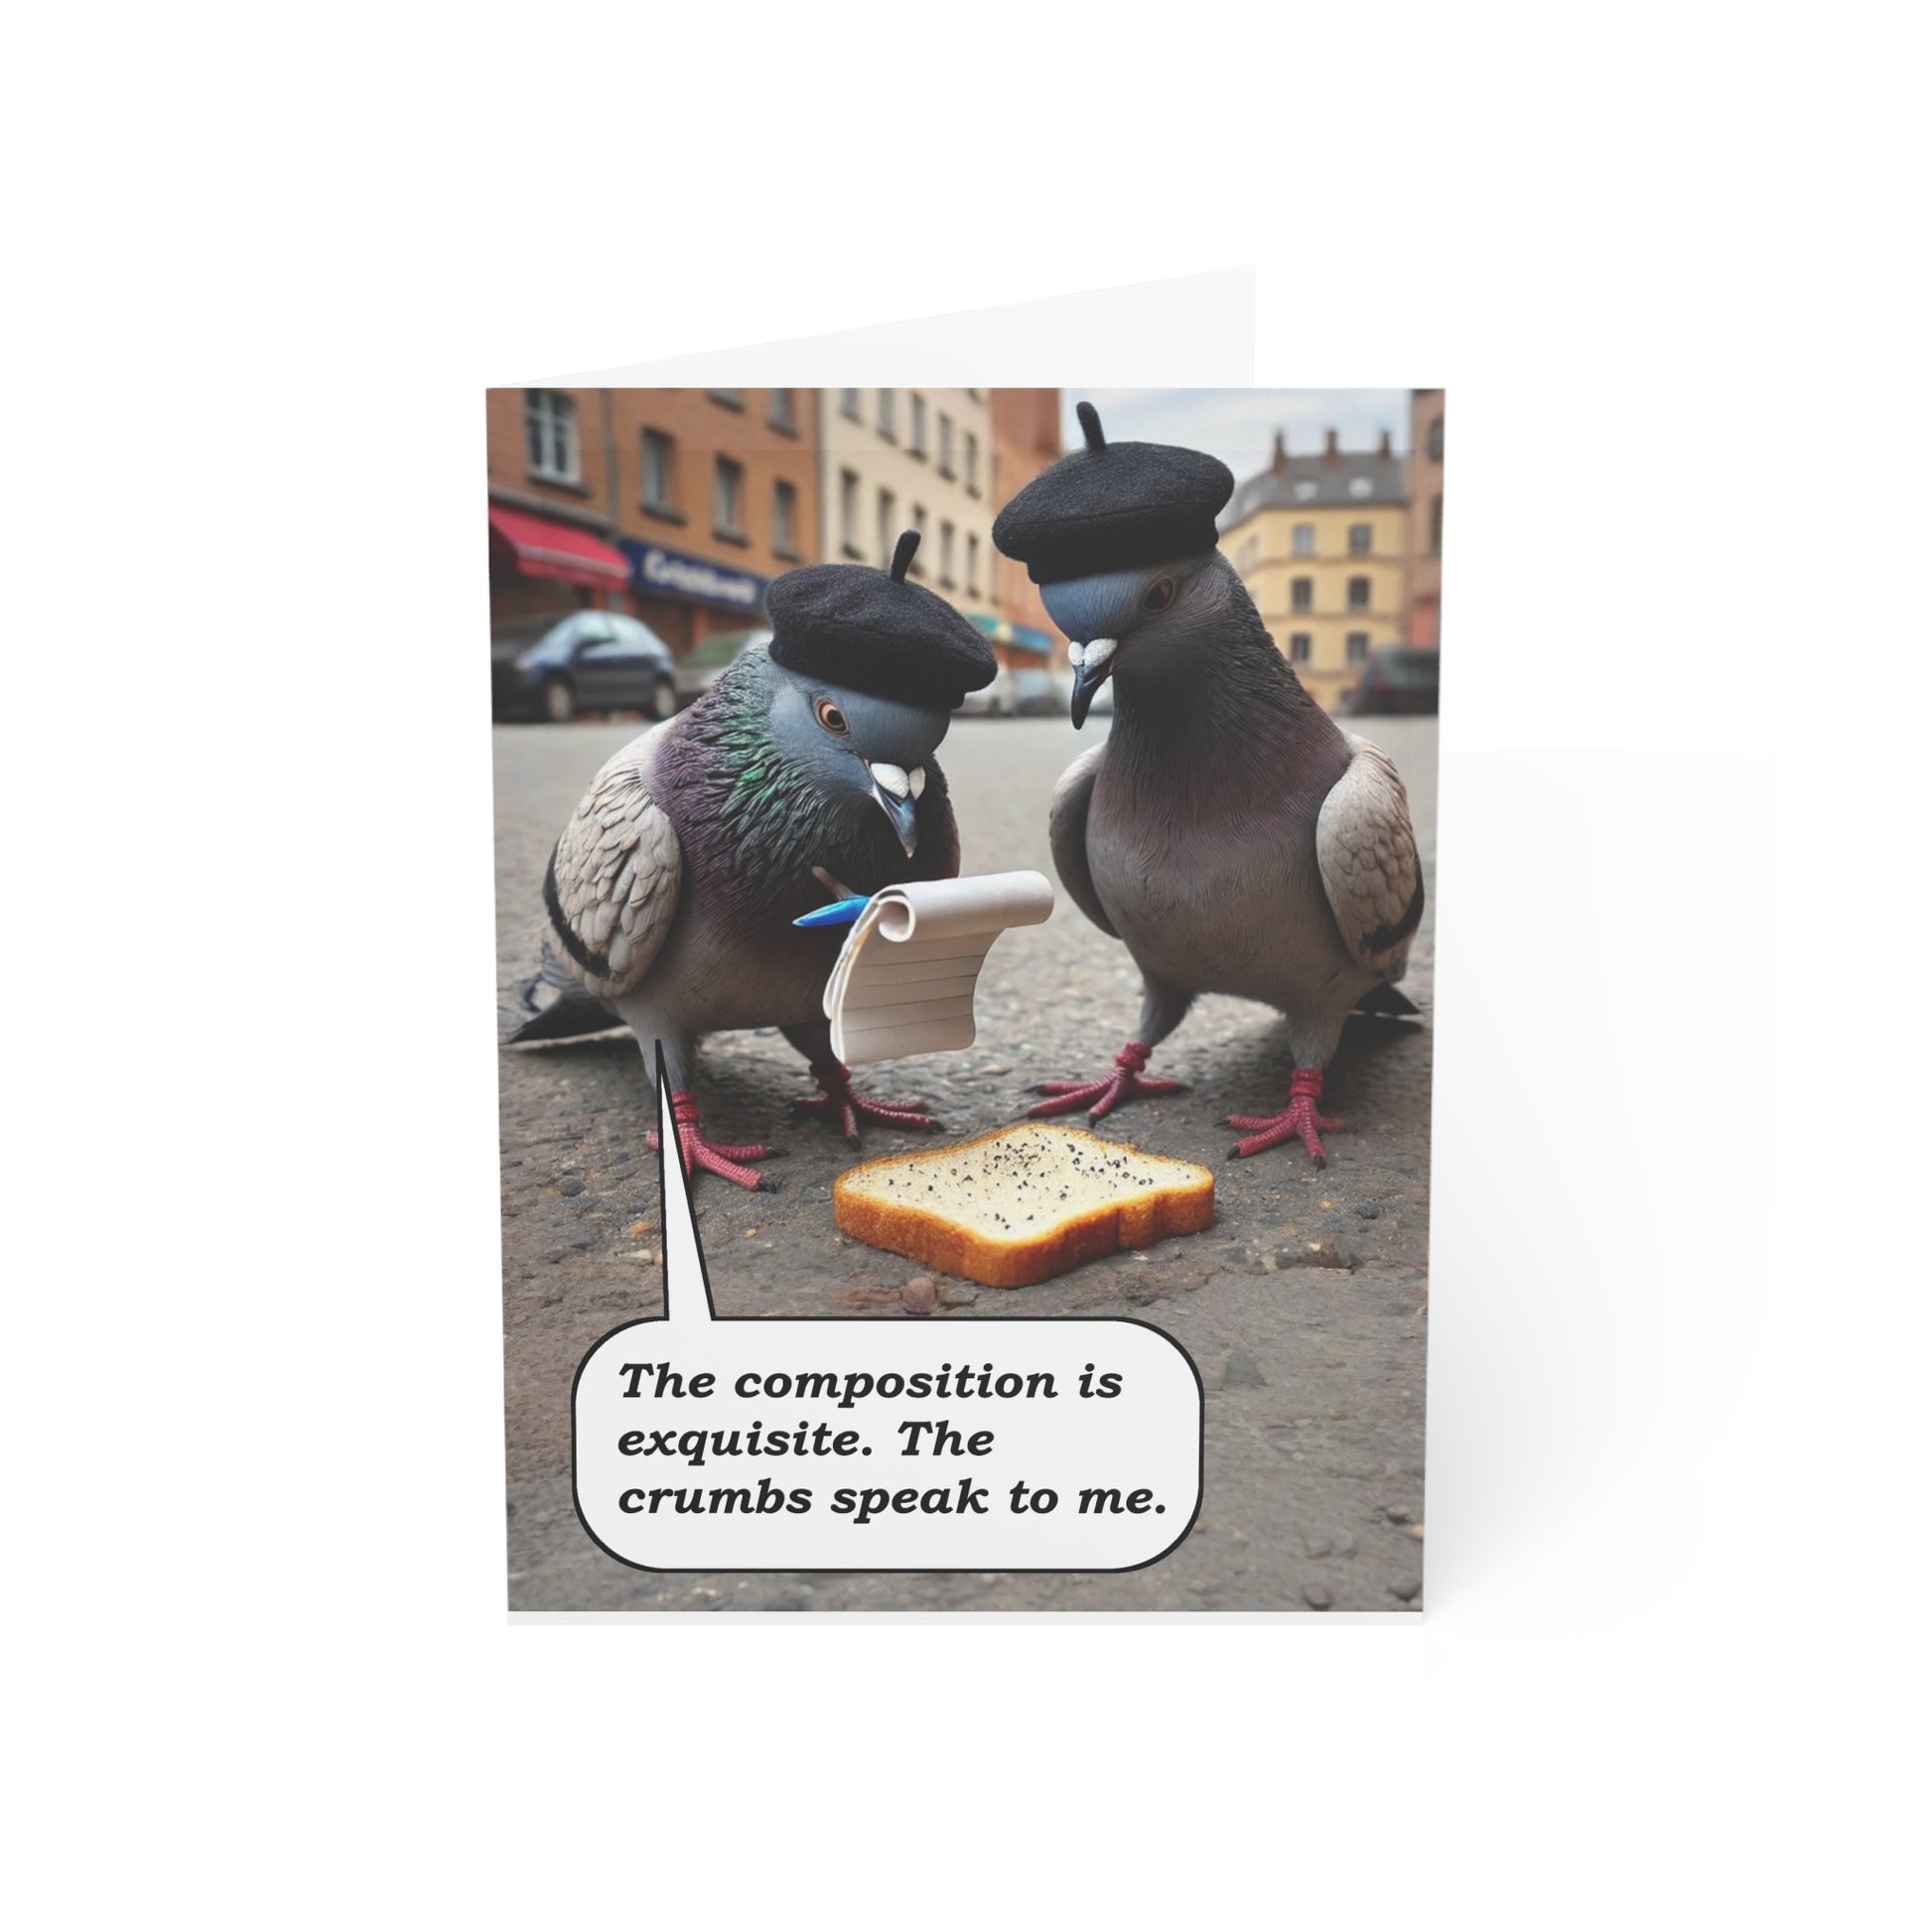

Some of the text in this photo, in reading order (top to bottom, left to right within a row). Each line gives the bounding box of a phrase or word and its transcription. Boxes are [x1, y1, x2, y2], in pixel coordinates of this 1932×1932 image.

[619, 1361, 1123, 1409] The composition is
[617, 1420, 995, 1466] exquisite. The
[619, 1477, 1166, 1524] crumbs speak to me.
